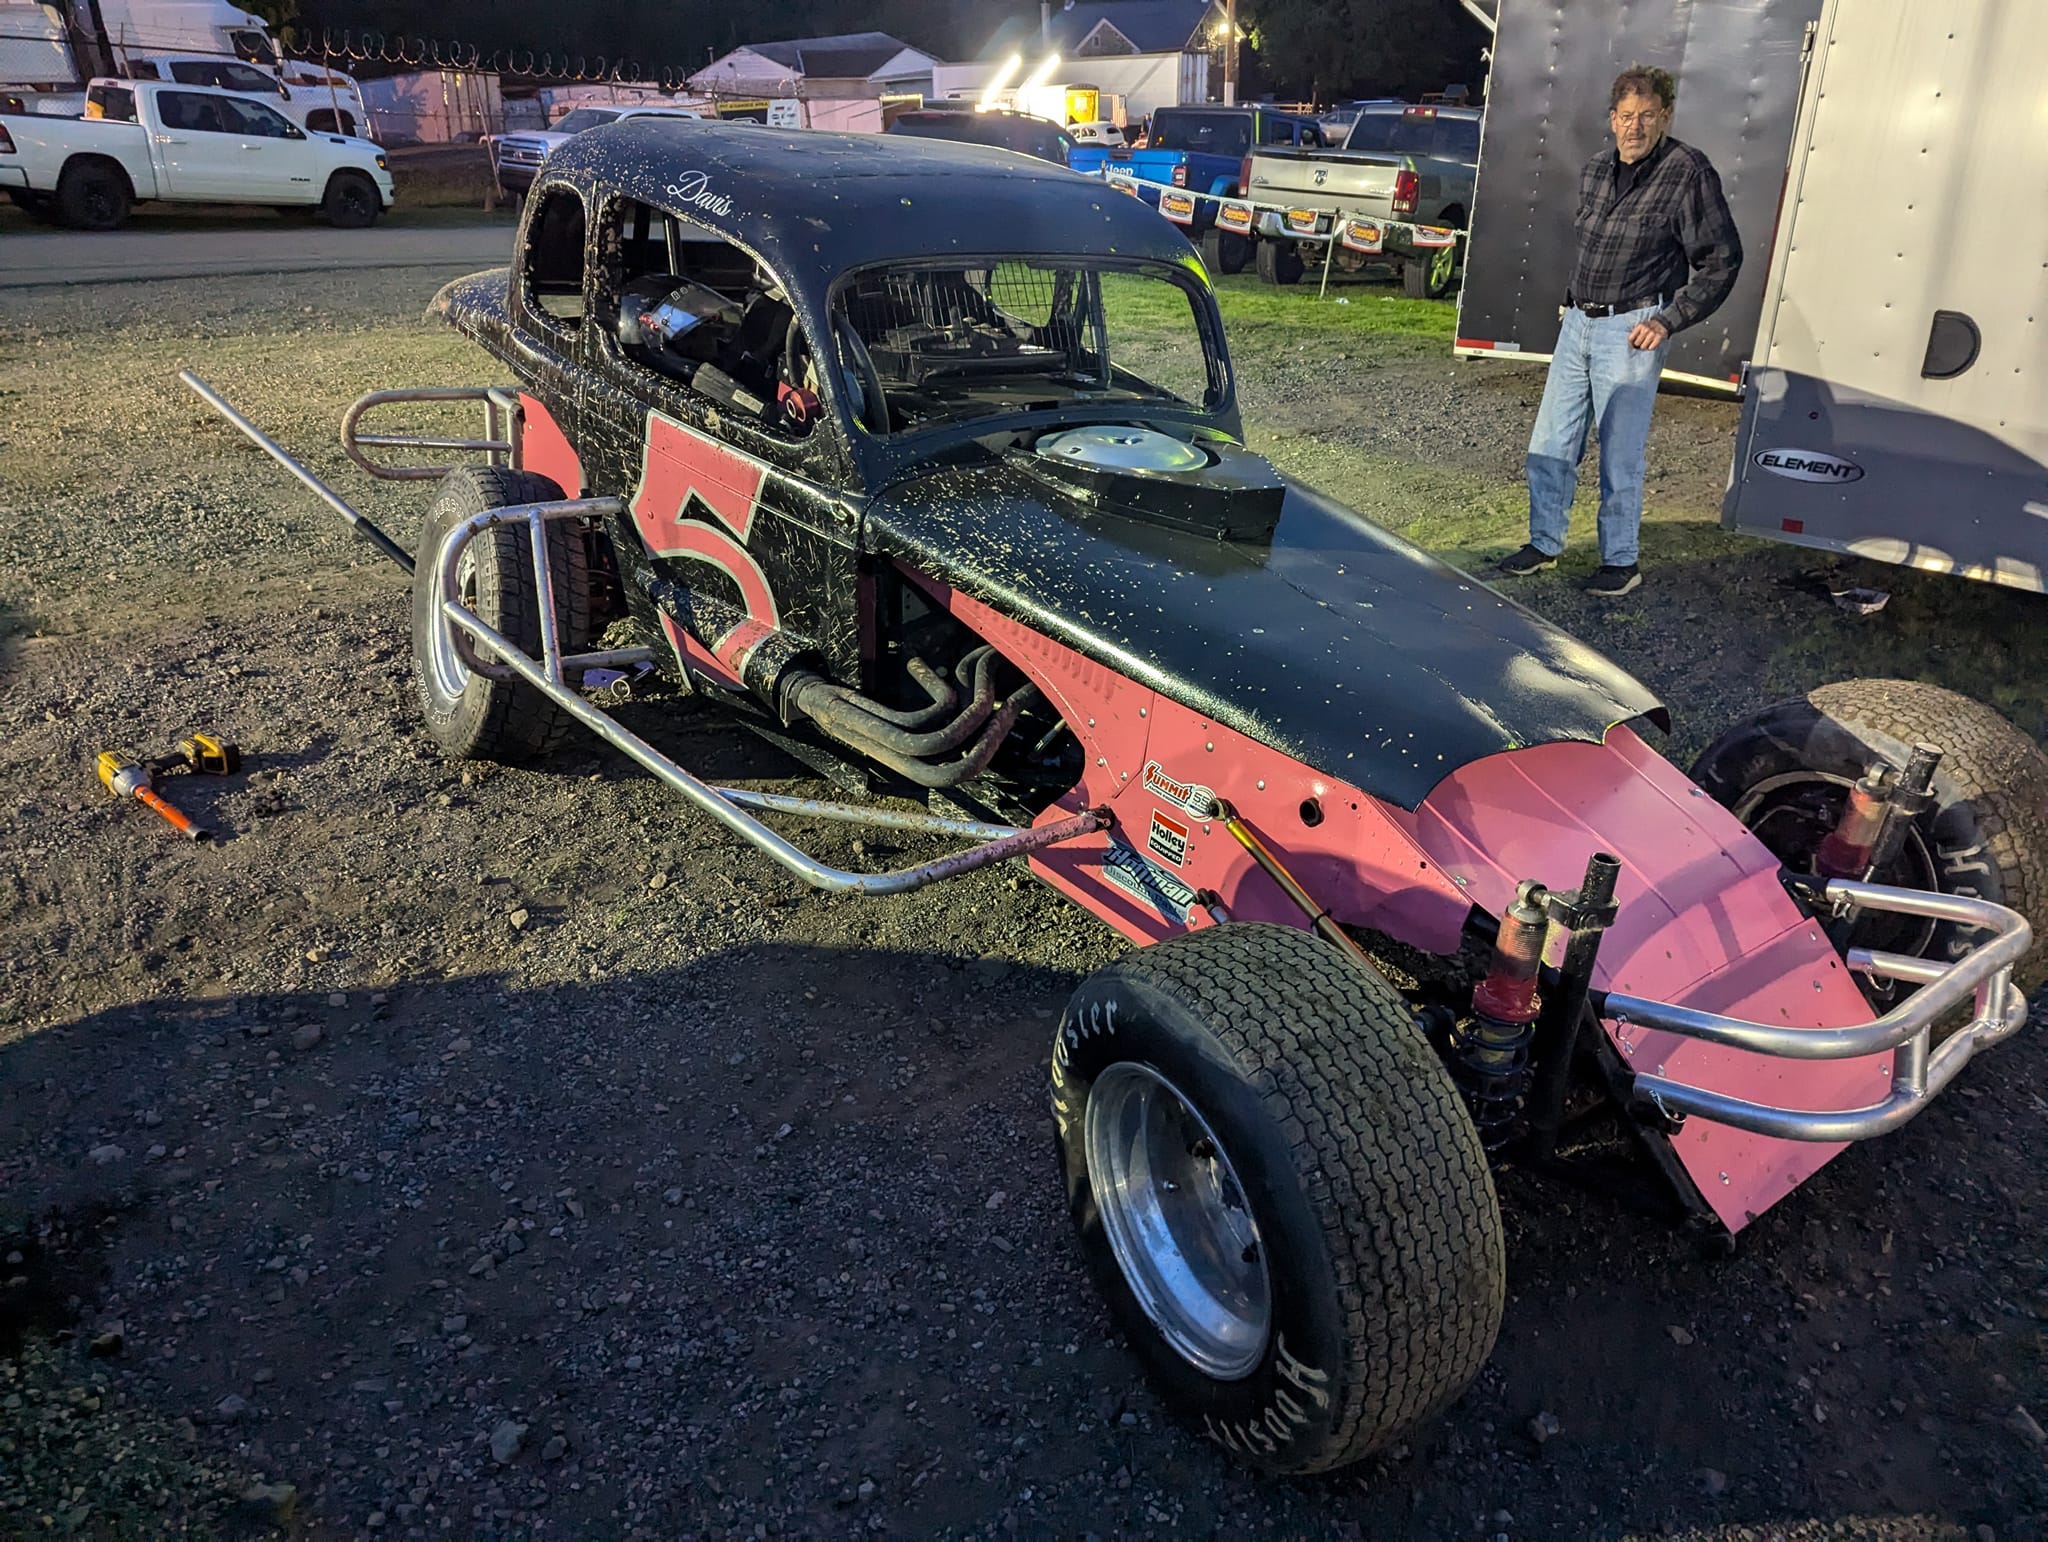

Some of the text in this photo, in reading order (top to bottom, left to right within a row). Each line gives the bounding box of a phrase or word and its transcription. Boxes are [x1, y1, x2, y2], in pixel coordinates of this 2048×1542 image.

[1109, 164, 1134, 177] Jeep
[666, 170, 734, 217] Davis
[1762, 454, 1856, 478] ELEMENT
[629, 409, 780, 690] 5
[1152, 821, 1185, 852] Holley
[1150, 839, 1182, 863] EQUIPPED
